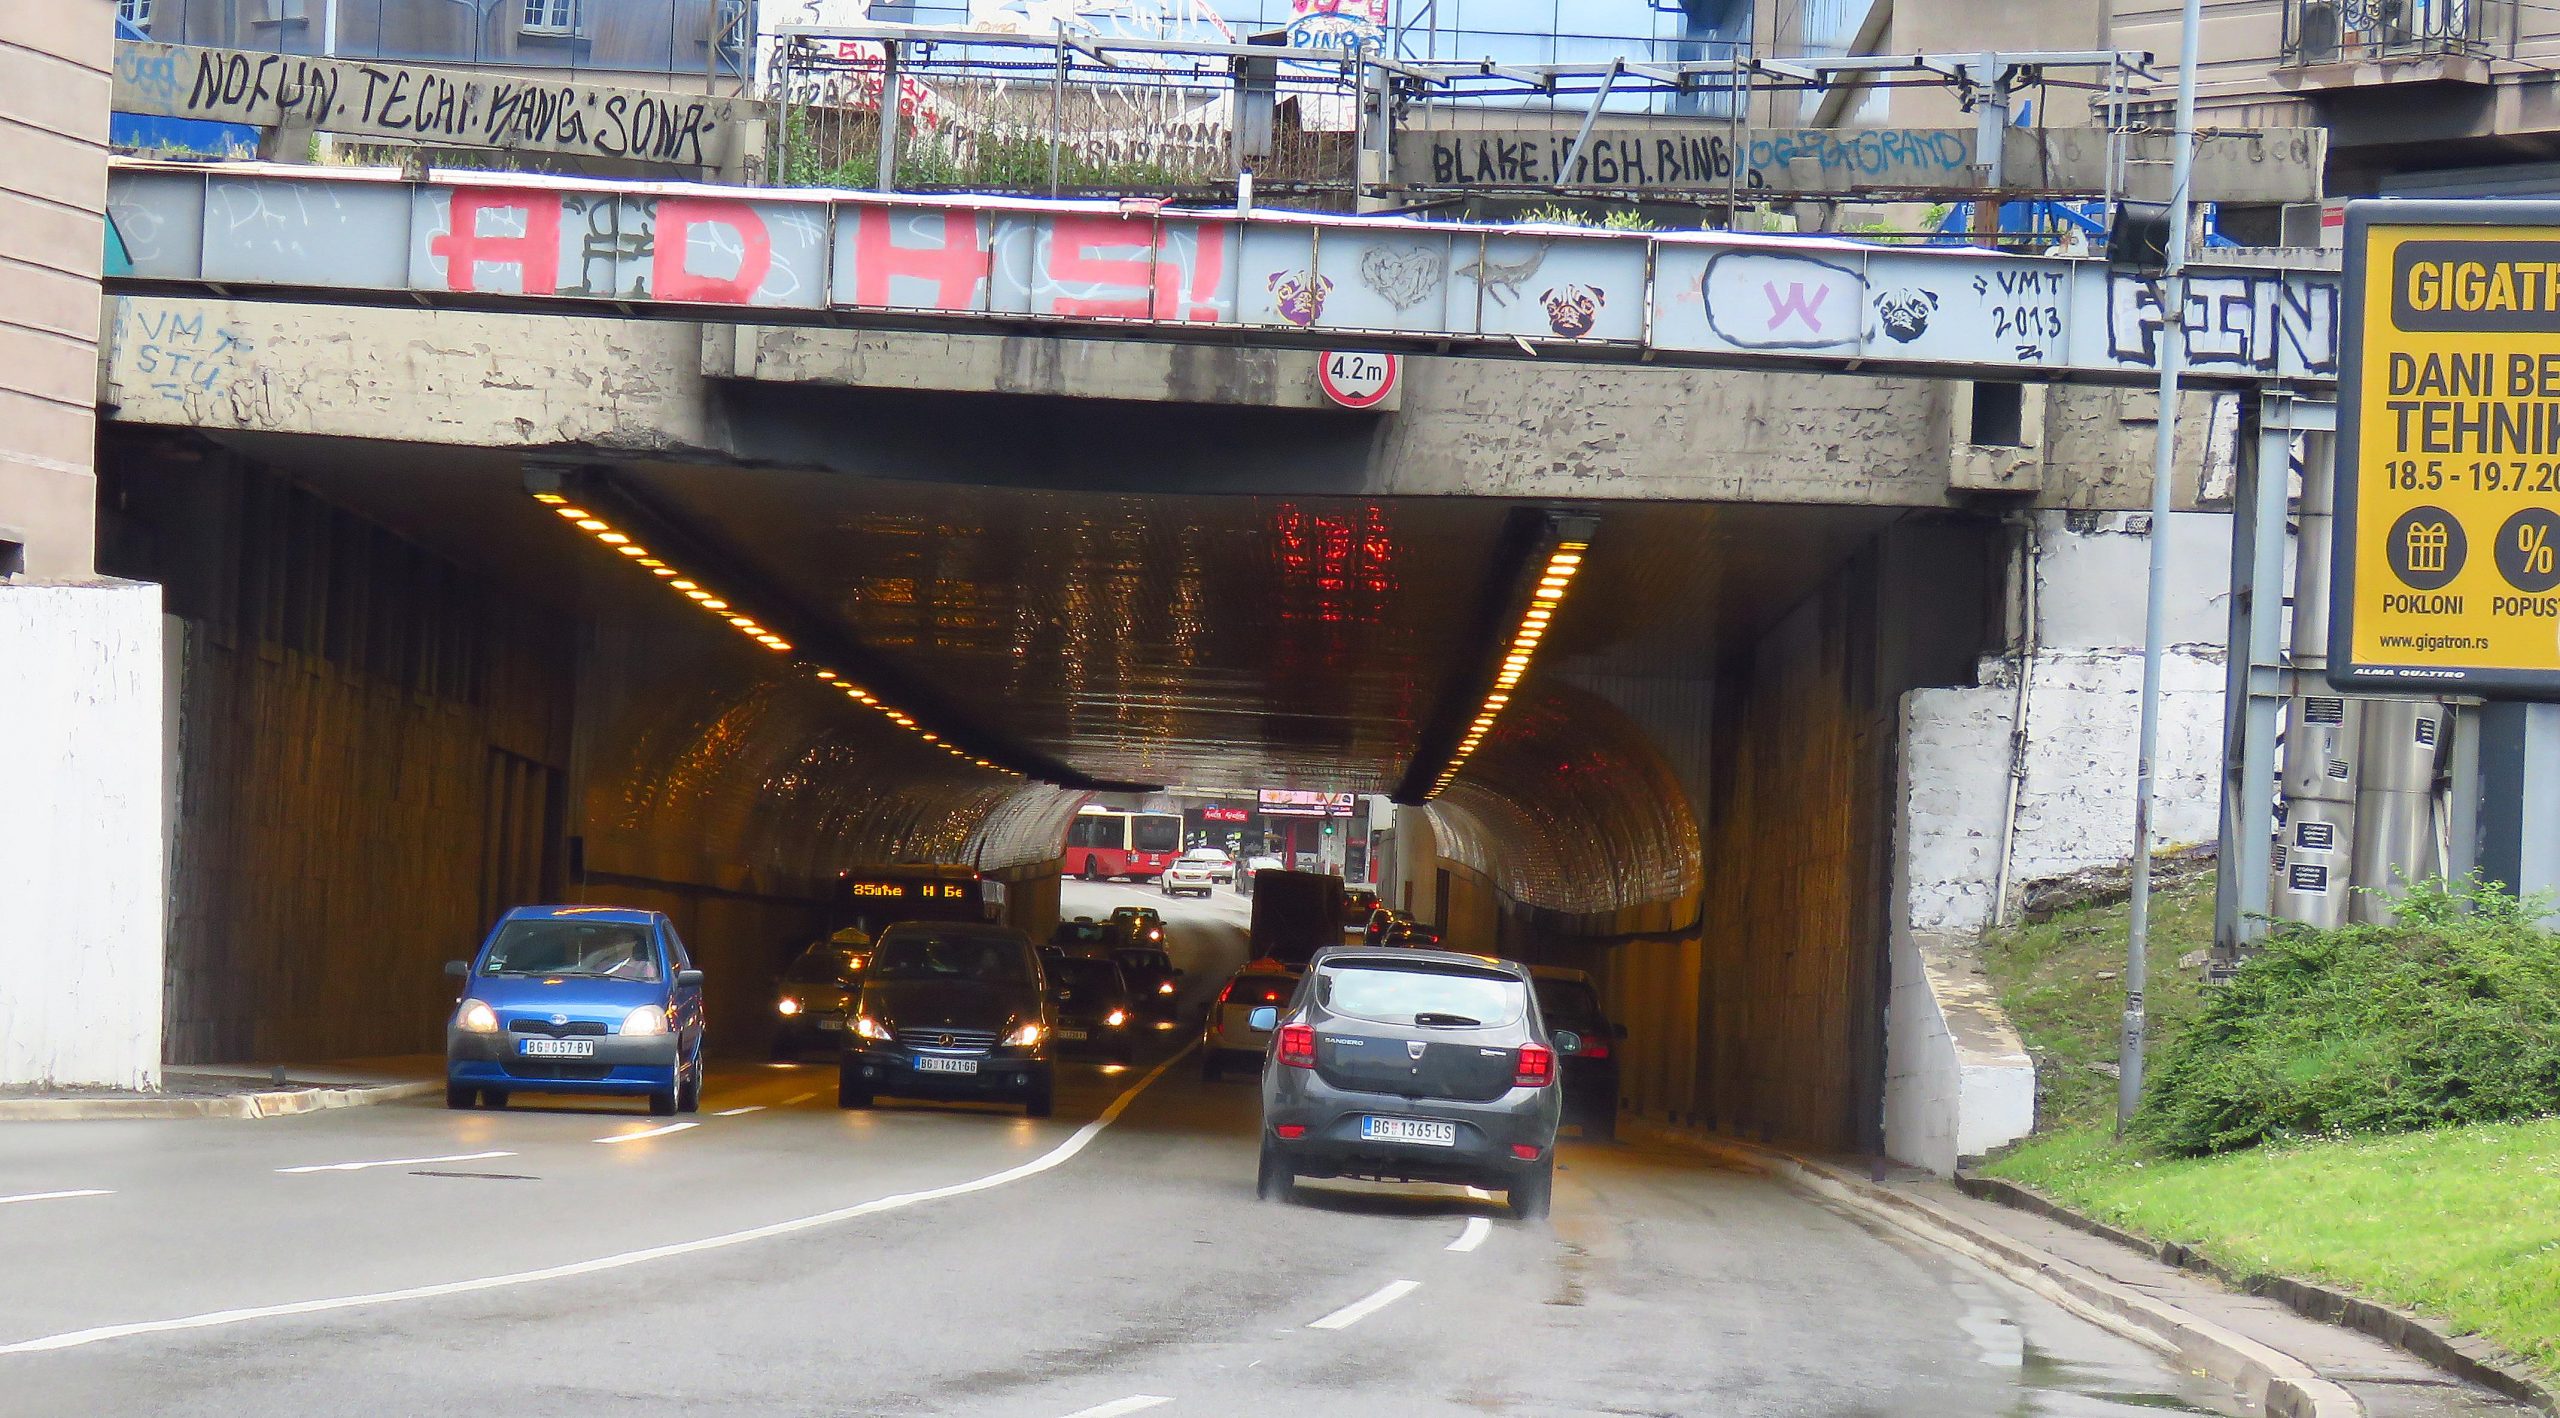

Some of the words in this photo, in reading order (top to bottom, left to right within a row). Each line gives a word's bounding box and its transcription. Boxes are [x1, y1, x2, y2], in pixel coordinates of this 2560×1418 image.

[1992, 306, 2062, 339] 2013
[2388, 352, 2494, 397] DANI
[2384, 460, 2443, 491] 18.5
[2382, 594, 2464, 614] POKLONI
[2492, 596, 2560, 617] POPUS
[2379, 633, 2489, 652] www.gigatron.rs
[2353, 667, 2395, 677] ALMA
[529, 1041, 543, 1053] BG
[1325, 1037, 1364, 1047] SANDERO
[921, 1058, 933, 1069] BG
[1373, 1120, 1390, 1134] BG
